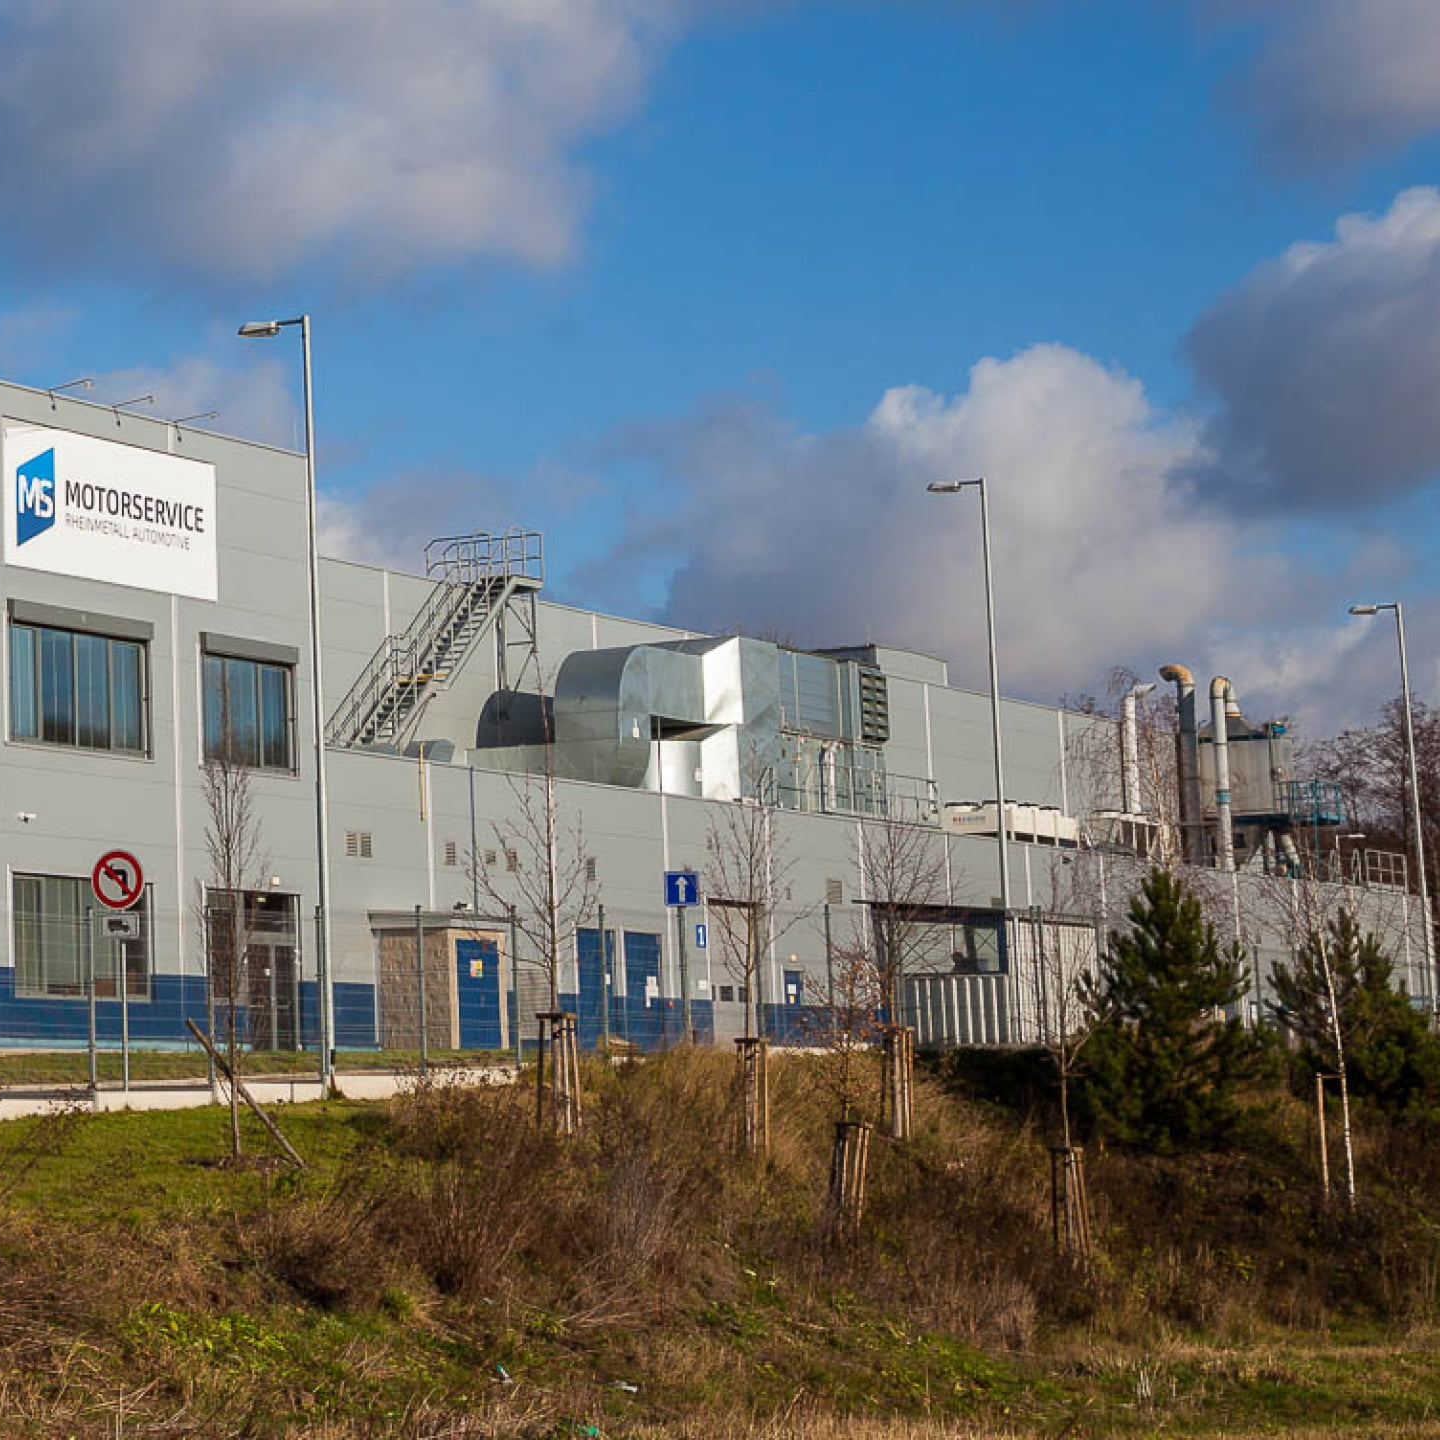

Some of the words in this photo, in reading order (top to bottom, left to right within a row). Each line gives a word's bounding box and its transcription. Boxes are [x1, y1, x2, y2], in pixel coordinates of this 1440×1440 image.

[18, 474, 53, 518] MS
[65, 480, 204, 533] MOTORSERVICE
[65, 513, 129, 539] RHEINMETALL
[133, 527, 190, 550] AUTOMOTIVE
[697, 926, 705, 946] 1
